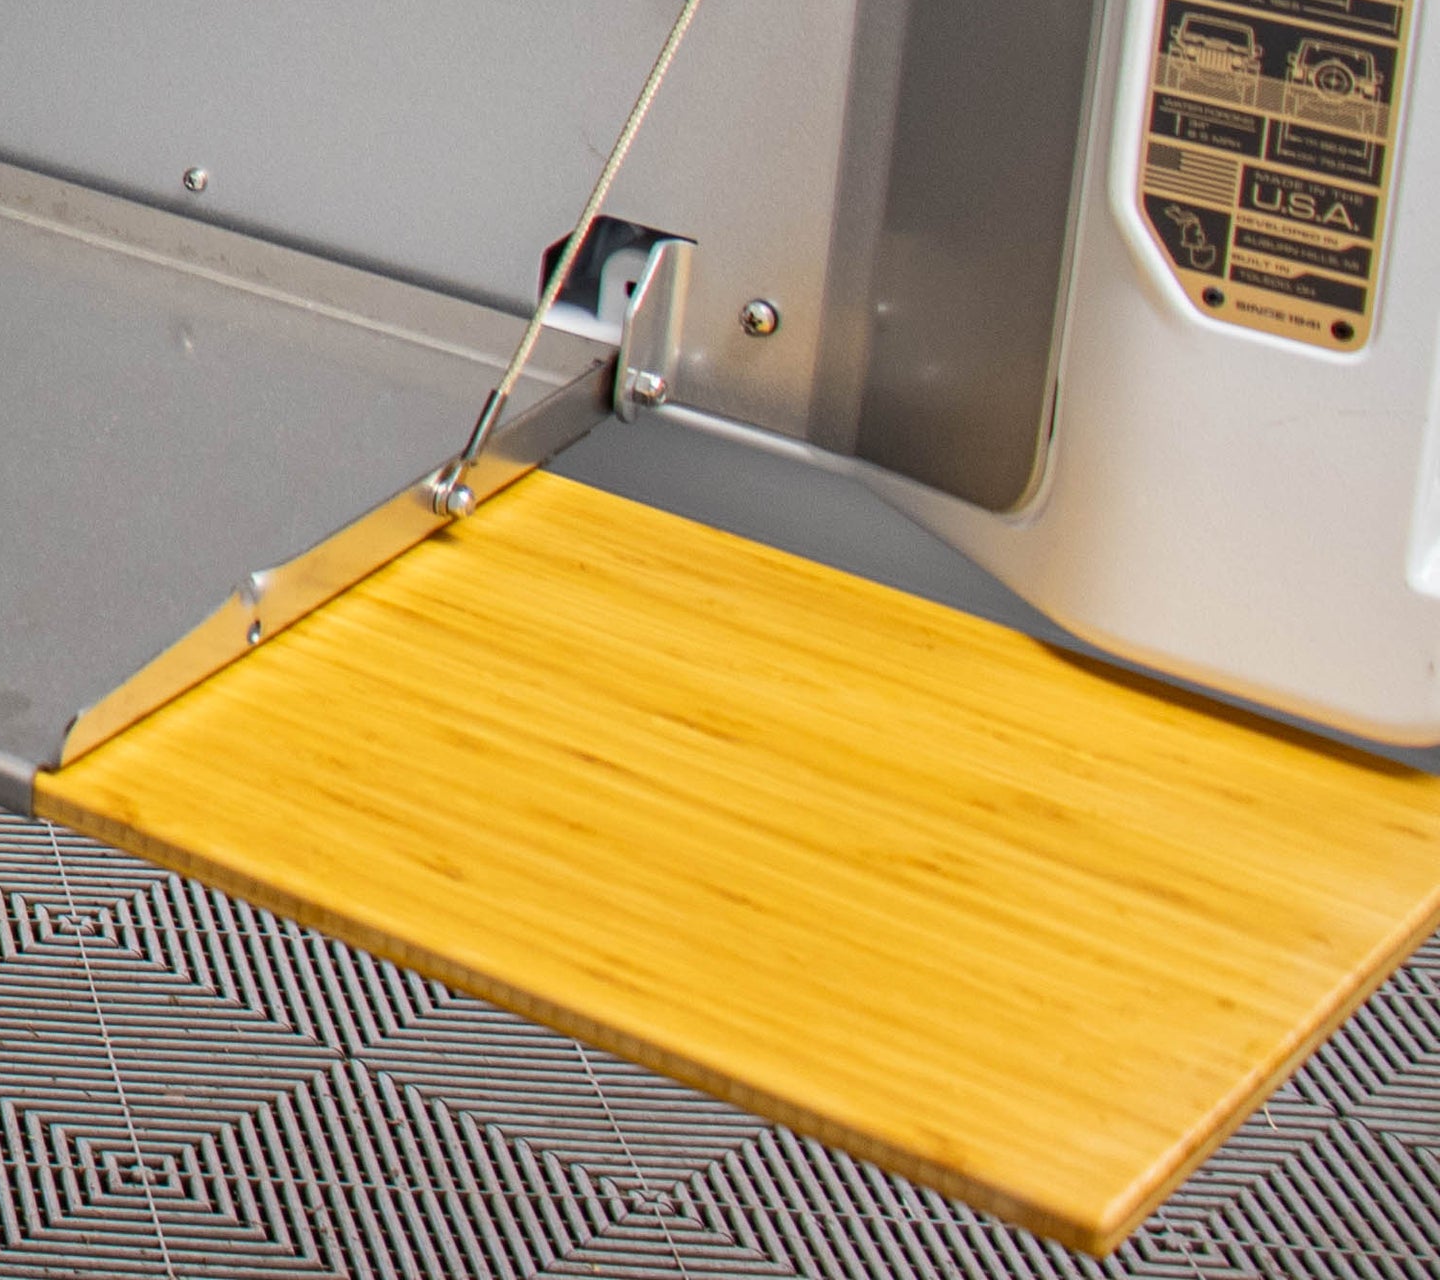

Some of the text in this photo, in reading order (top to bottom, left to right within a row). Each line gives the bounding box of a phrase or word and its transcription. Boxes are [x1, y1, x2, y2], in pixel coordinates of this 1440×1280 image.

[1254, 171, 1364, 205] MADE IN THE
[1253, 182, 1360, 232] U.S.A.
[1236, 214, 1339, 246] DEVELOPED IN
[1236, 300, 1286, 322] SINCE
